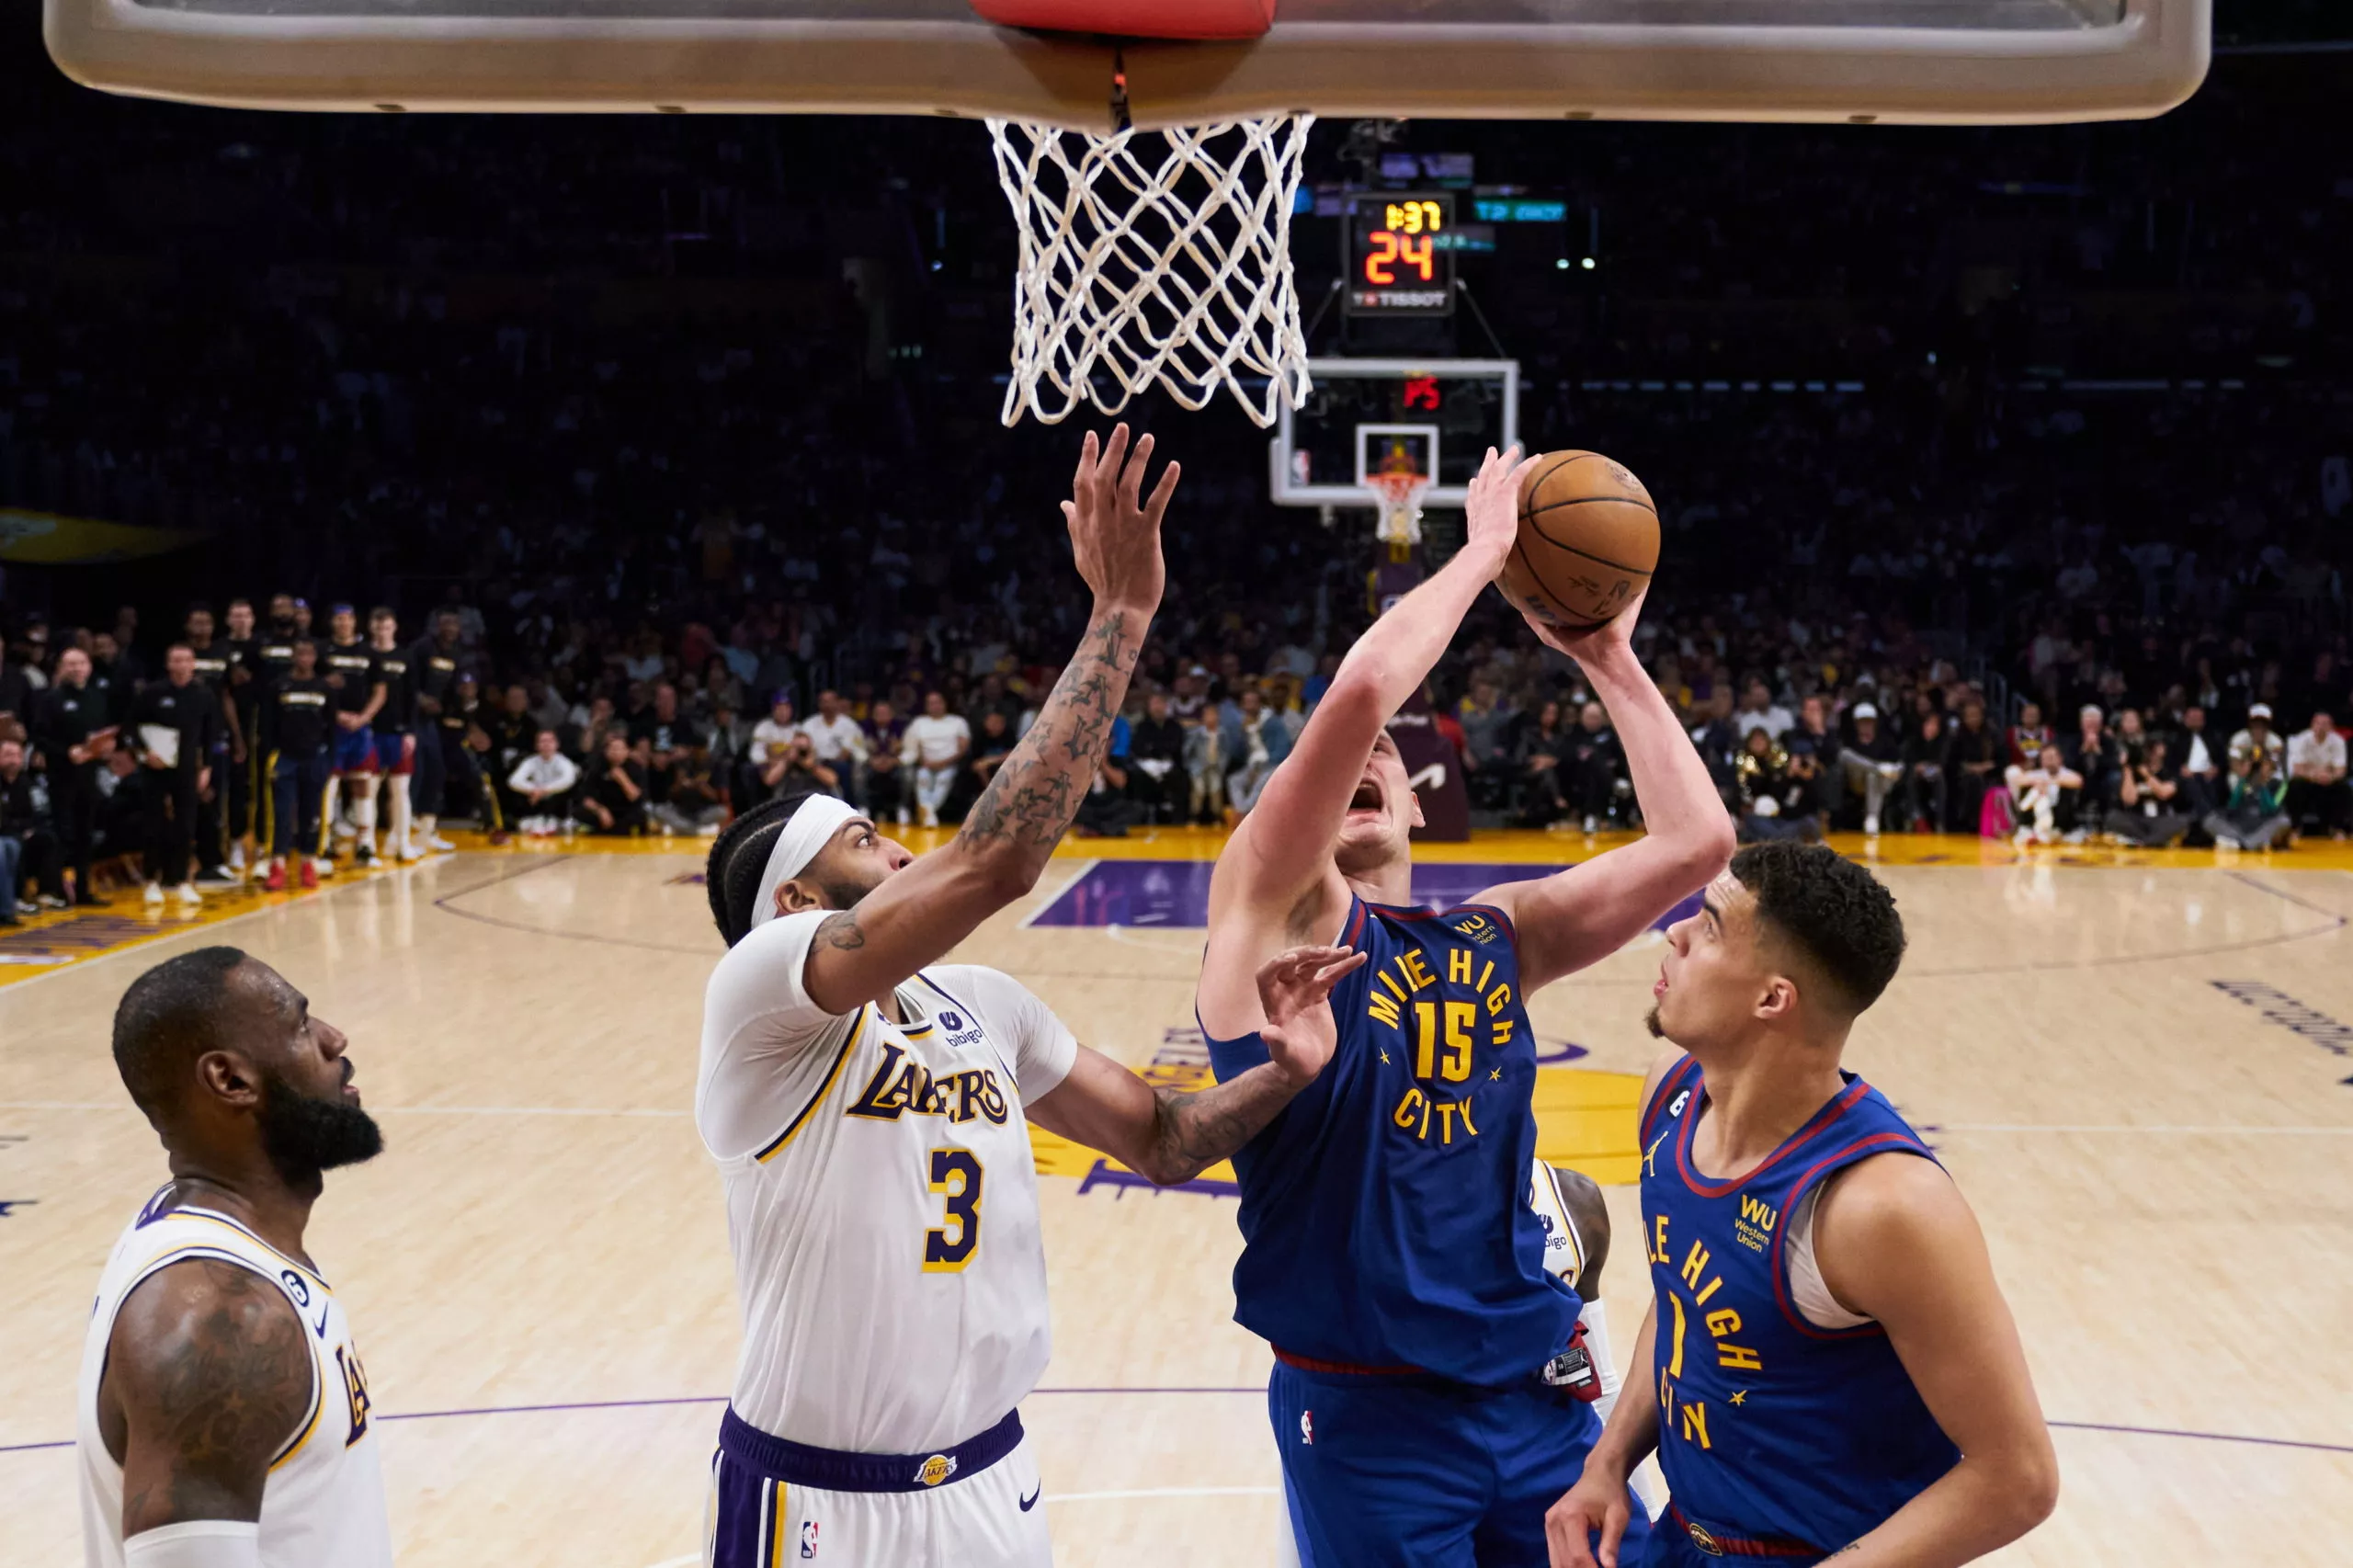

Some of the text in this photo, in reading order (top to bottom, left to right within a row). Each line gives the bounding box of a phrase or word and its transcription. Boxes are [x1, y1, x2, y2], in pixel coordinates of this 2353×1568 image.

[1366, 232, 1433, 285] 24
[1379, 291, 1446, 307] TISSOT
[1449, 948, 1514, 1045] HIGH
[945, 1029, 983, 1047] bibigo
[1415, 1001, 1477, 1083] 15
[845, 1040, 1008, 1127] LAKERS
[1669, 1090, 1691, 1118] 6
[1393, 1088, 1479, 1144] CITY
[922, 1147, 984, 1273] 3
[1734, 1218, 1769, 1245] Western
[1742, 1194, 1777, 1232] WU
[1736, 1232, 1762, 1253] Union
[1681, 1238, 1763, 1370] HIGH
[1668, 1290, 1687, 1379] 1
